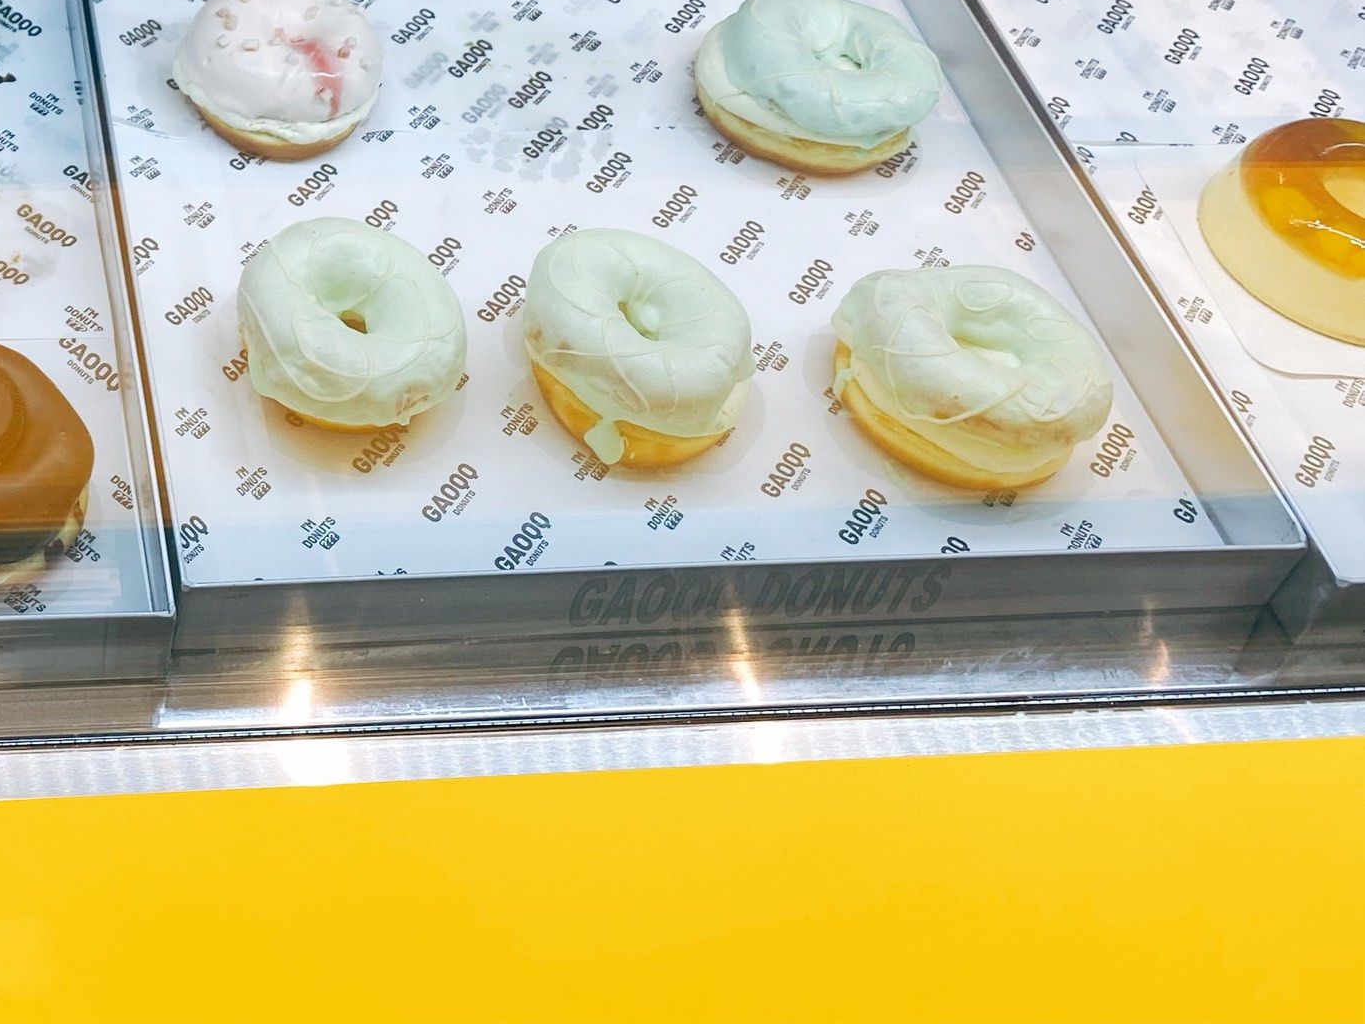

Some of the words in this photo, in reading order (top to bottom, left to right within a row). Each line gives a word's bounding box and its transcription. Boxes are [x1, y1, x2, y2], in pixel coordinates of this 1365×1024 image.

[65, 306, 103, 331] DONUTS
[67, 360, 94, 384] DONUTS
[237, 468, 267, 496] DONUTS
[453, 490, 475, 515] DONUTS
[647, 496, 677, 530] DONUTS
[302, 517, 335, 548] DONUTS
[869, 516, 888, 538] DONUTS
[1068, 520, 1092, 549] DONUTS
[526, 540, 548, 566] DONUTS
[747, 563, 952, 619] DONUTS
